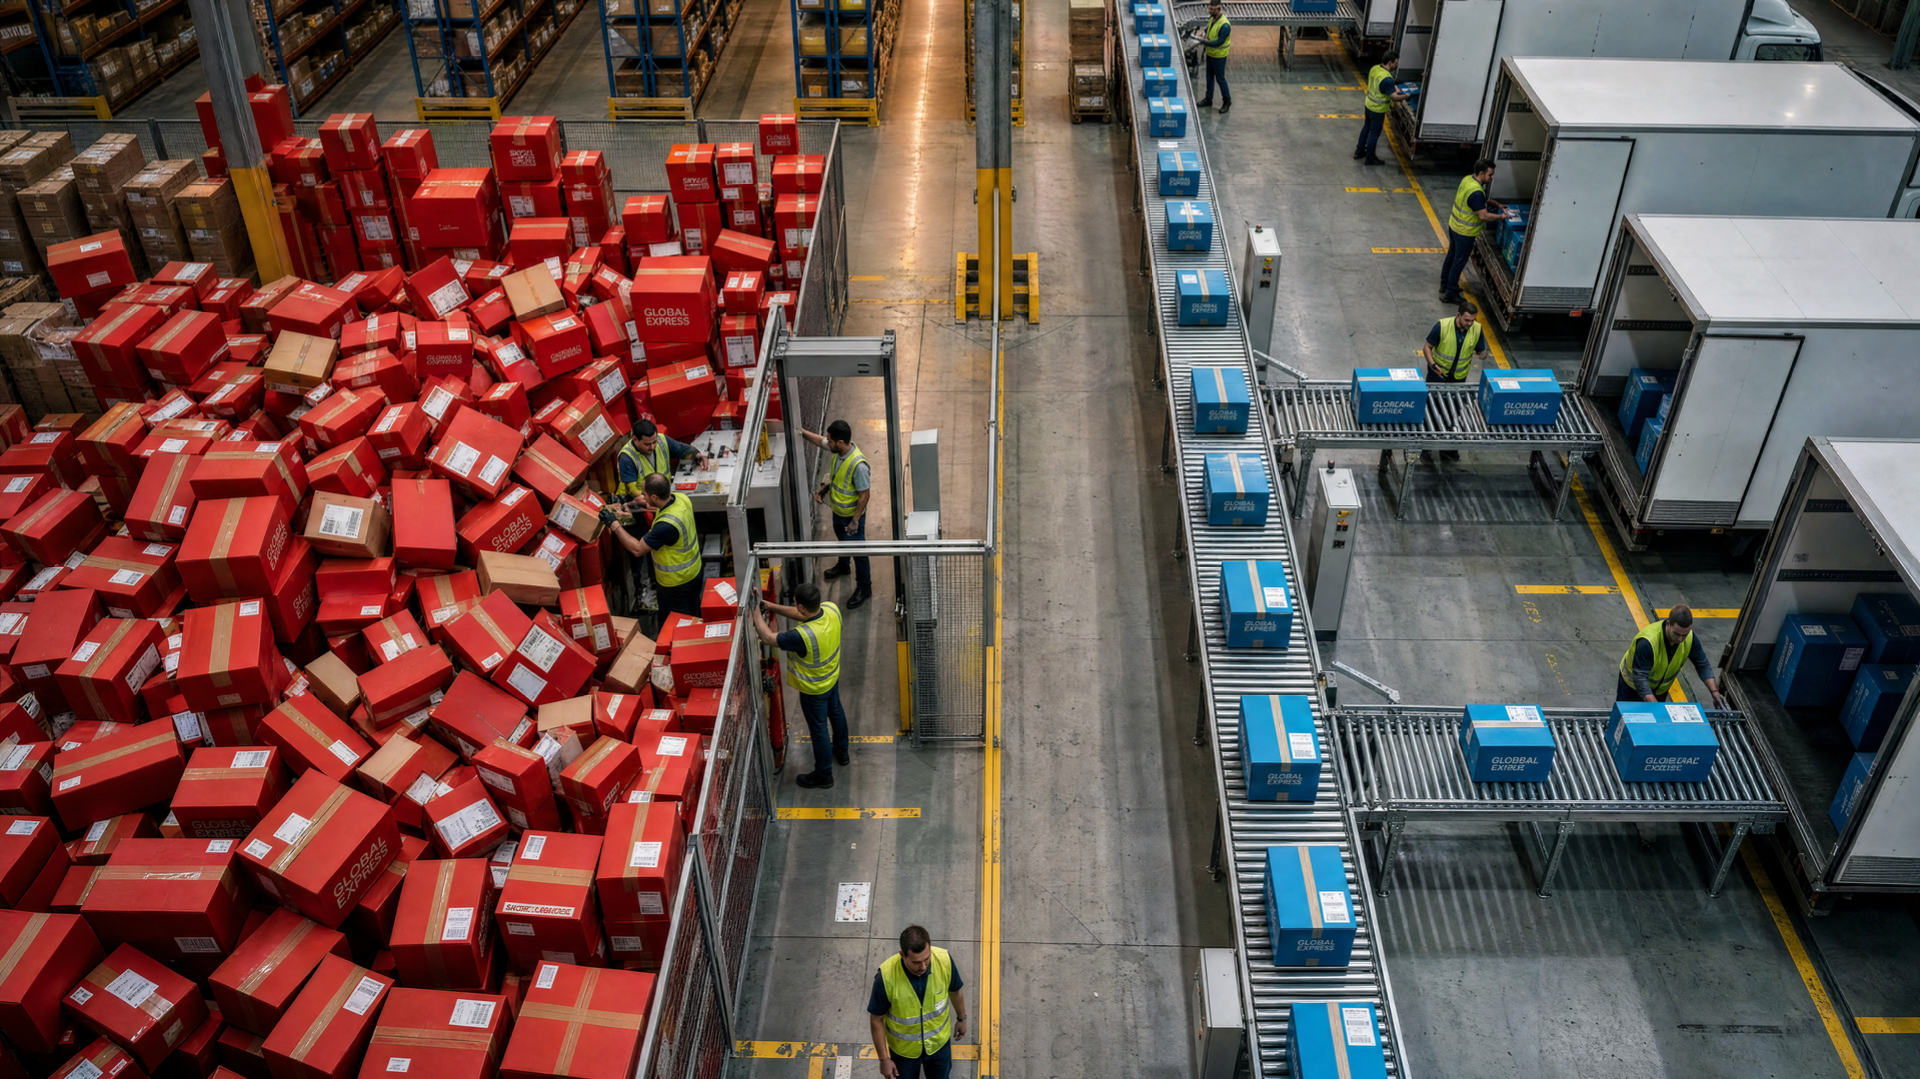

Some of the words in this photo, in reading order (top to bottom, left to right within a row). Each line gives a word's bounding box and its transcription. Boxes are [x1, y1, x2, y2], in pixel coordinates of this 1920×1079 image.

[644, 308, 689, 317] GLOBAL
[646, 317, 690, 326] EXPRESS
[492, 513, 529, 547] GLOBAL
[334, 837, 386, 898] GLOBAL
[337, 844, 389, 910] EXPRESS
